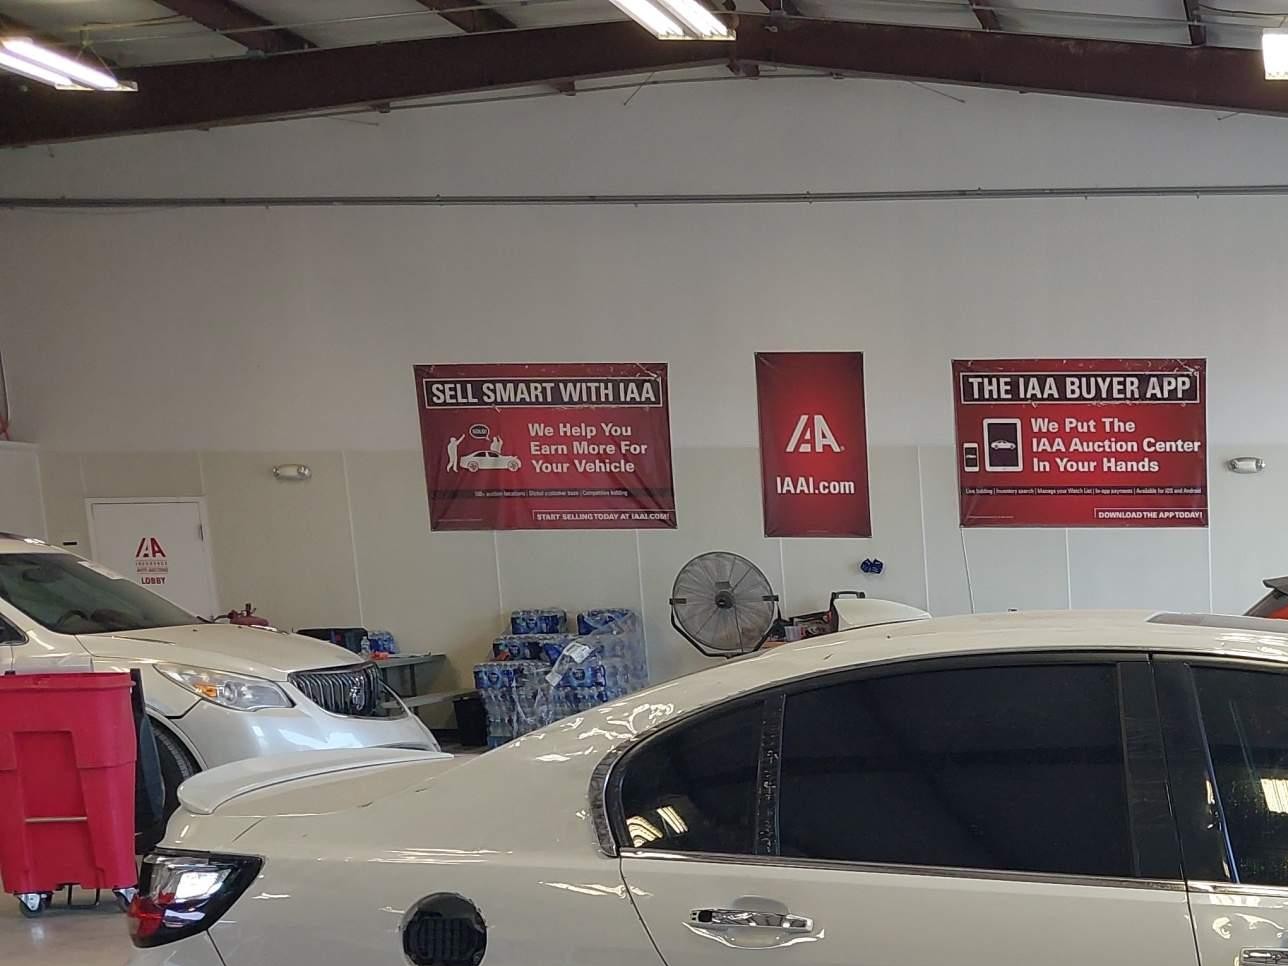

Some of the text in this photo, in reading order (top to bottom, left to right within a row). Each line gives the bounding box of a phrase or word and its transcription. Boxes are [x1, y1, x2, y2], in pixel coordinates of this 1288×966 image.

[431, 382, 656, 404] SELL SMART WITH IAA
[968, 376, 1191, 399] THE IAA BUYER APP
[528, 422, 632, 439] We Help You
[1031, 418, 1136, 433] We Put The
[530, 440, 648, 455] Earn More For
[1032, 437, 1201, 452] IAA Auction Center
[531, 459, 635, 473] Your Vehicle
[1033, 458, 1160, 472] In Your Hands
[776, 476, 855, 495] IAAI.com
[537, 513, 561, 521] START
[562, 513, 594, 521] SELLING
[1098, 511, 1203, 519] DOWNLOAD THE APP TODAY!
[141, 577, 165, 585] LOBBY
